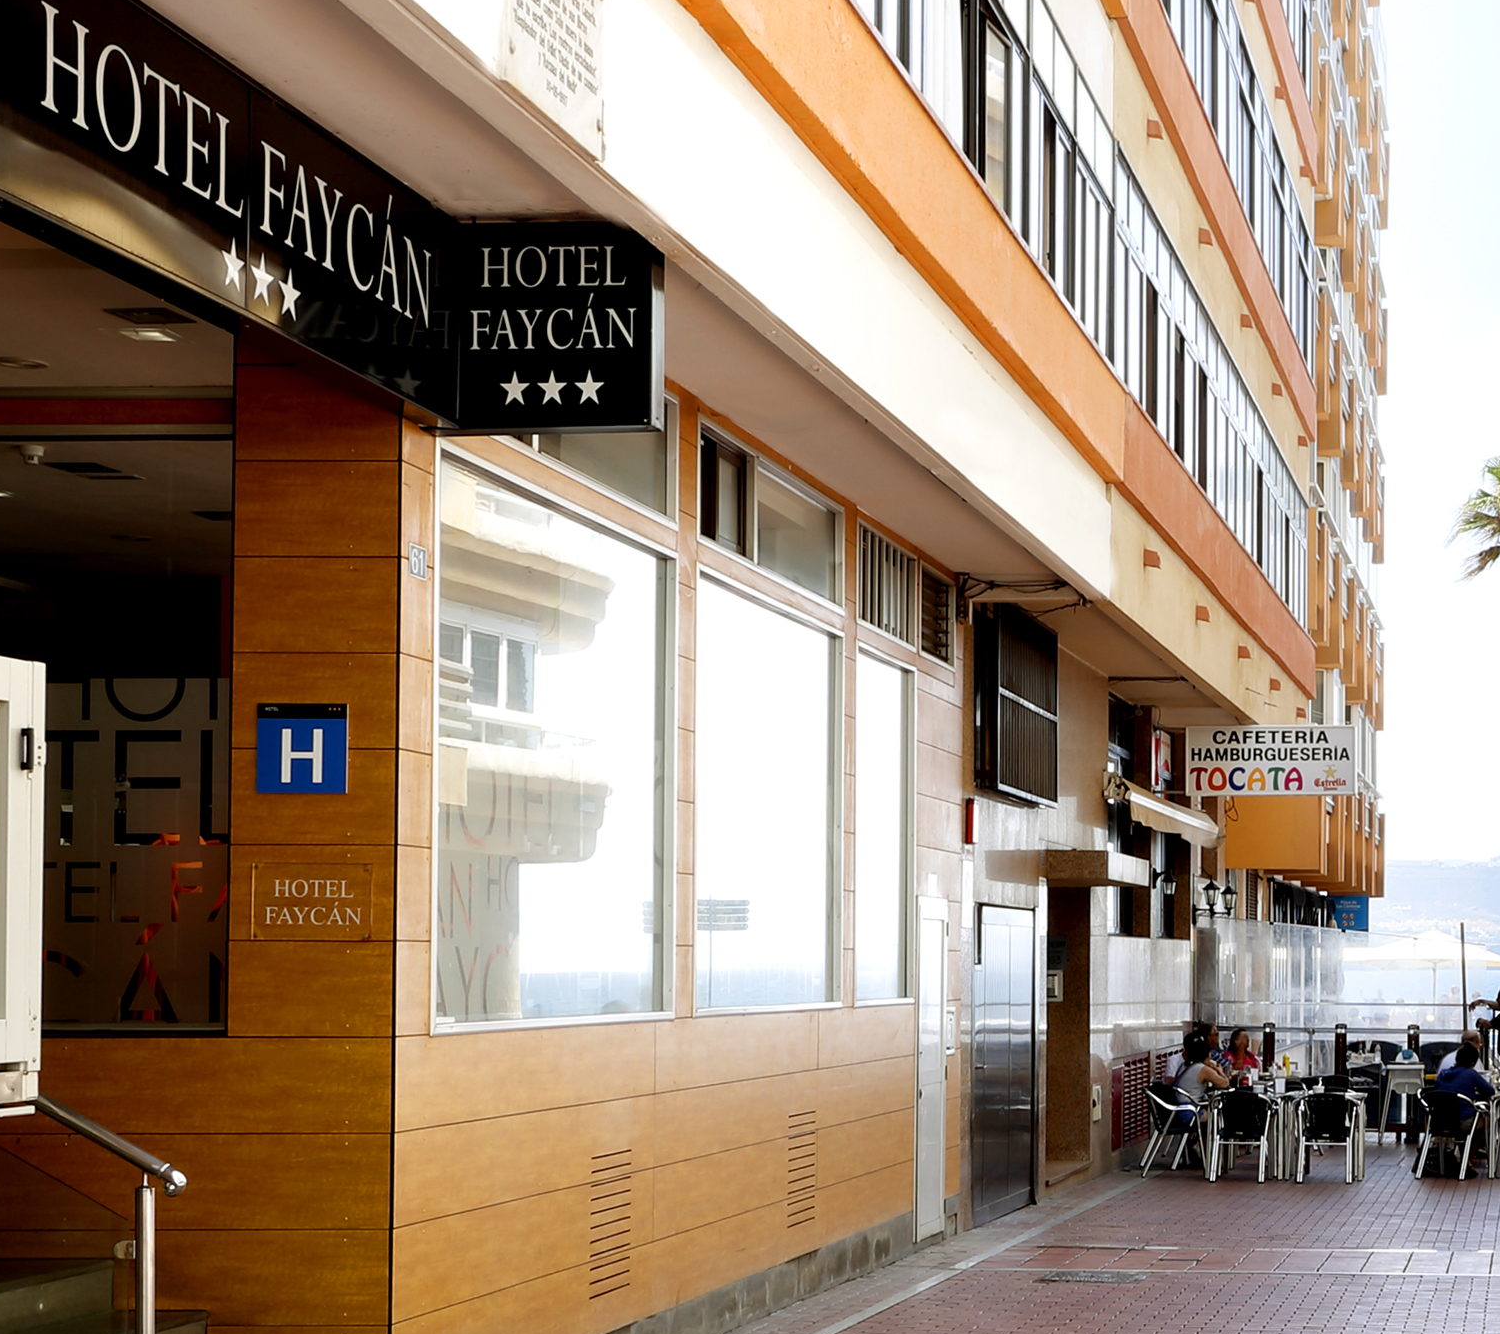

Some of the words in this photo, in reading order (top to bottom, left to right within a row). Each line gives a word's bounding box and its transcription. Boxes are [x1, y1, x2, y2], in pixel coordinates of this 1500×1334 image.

[40, 0, 245, 220] HOTEL
[259, 140, 432, 329] FAYCÁN
[480, 245, 627, 288] HOTEL
[469, 292, 638, 350] FAYCÁN
[1212, 728, 1329, 745] CAFETERÍA
[280, 728, 324, 784] H
[1190, 746, 1350, 762] HAMBURGUESERÍA
[1189, 767, 1303, 791] TOCATA
[272, 879, 355, 899] HOTEL
[263, 900, 363, 926] FAYCÁN
